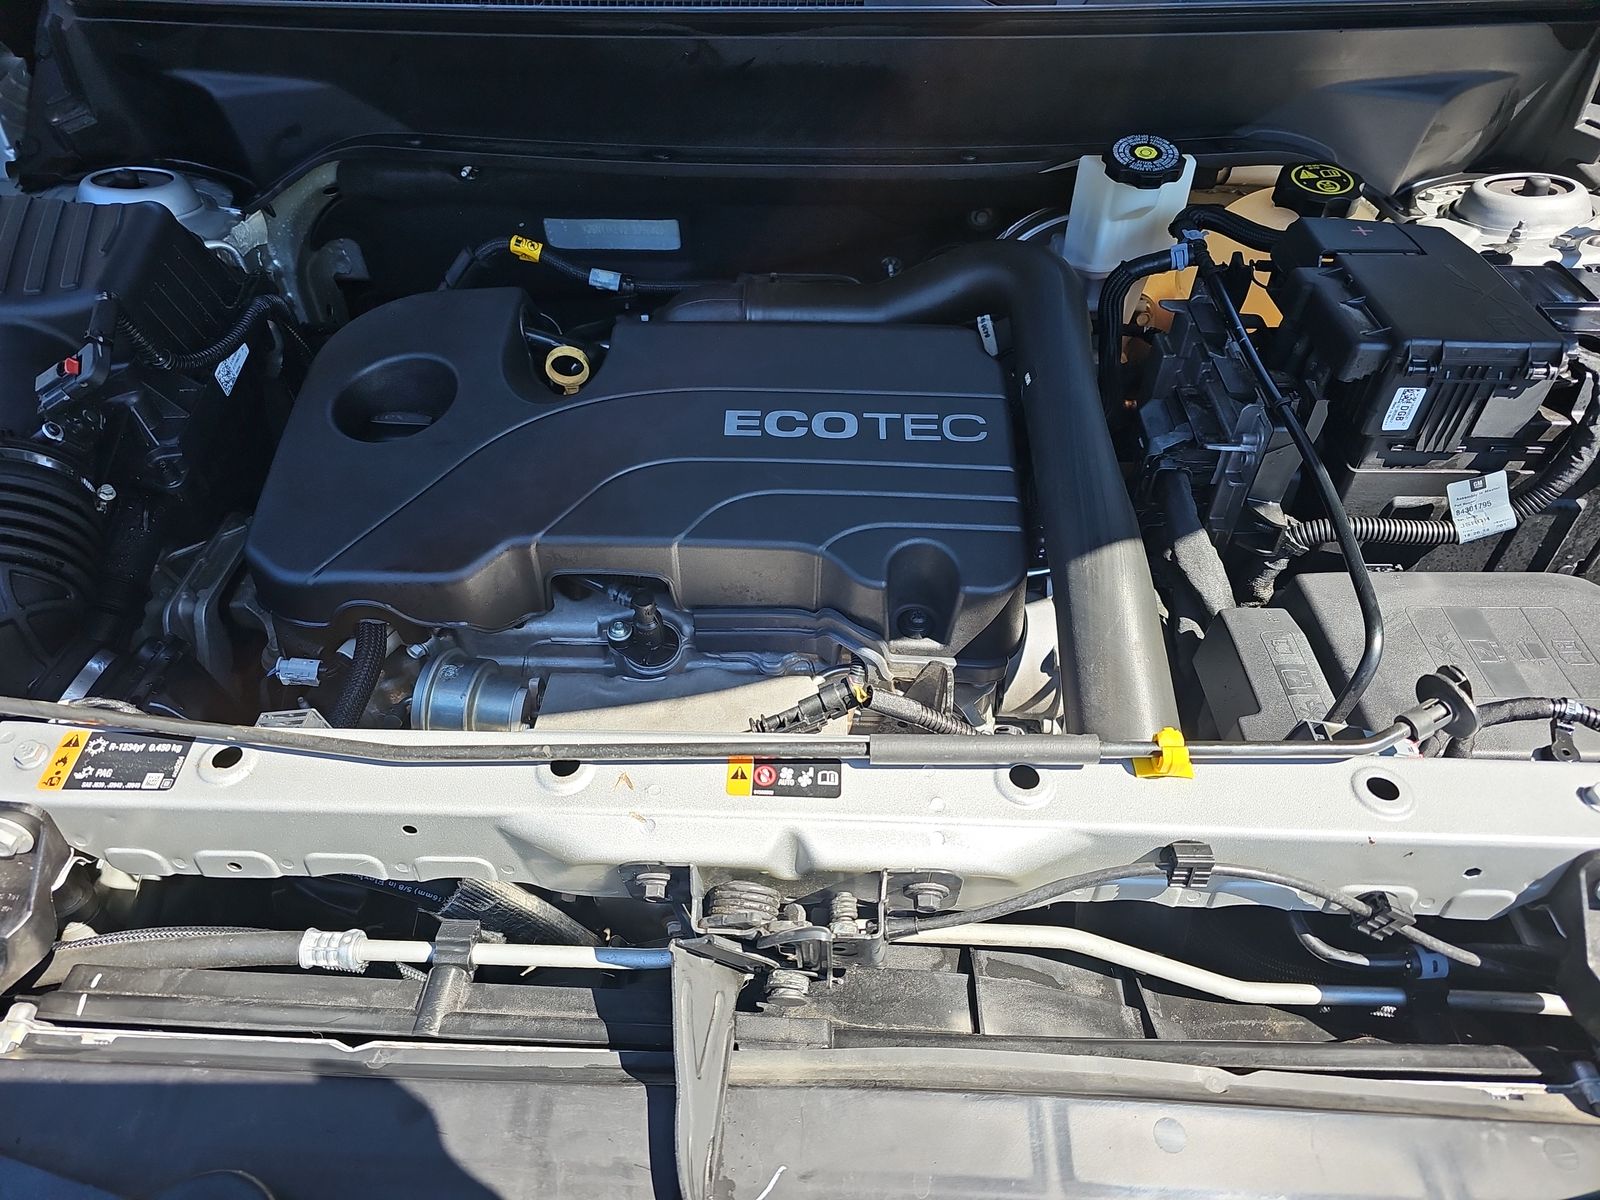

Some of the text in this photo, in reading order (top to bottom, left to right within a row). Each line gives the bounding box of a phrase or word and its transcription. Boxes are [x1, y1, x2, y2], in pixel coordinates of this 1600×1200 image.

[1395, 405, 1410, 421] DGB
[723, 409, 988, 442] ECOTEC
[1472, 479, 1484, 488] GM
[95, 768, 113, 778] PAG
[778, 778, 795, 786] AUTO
